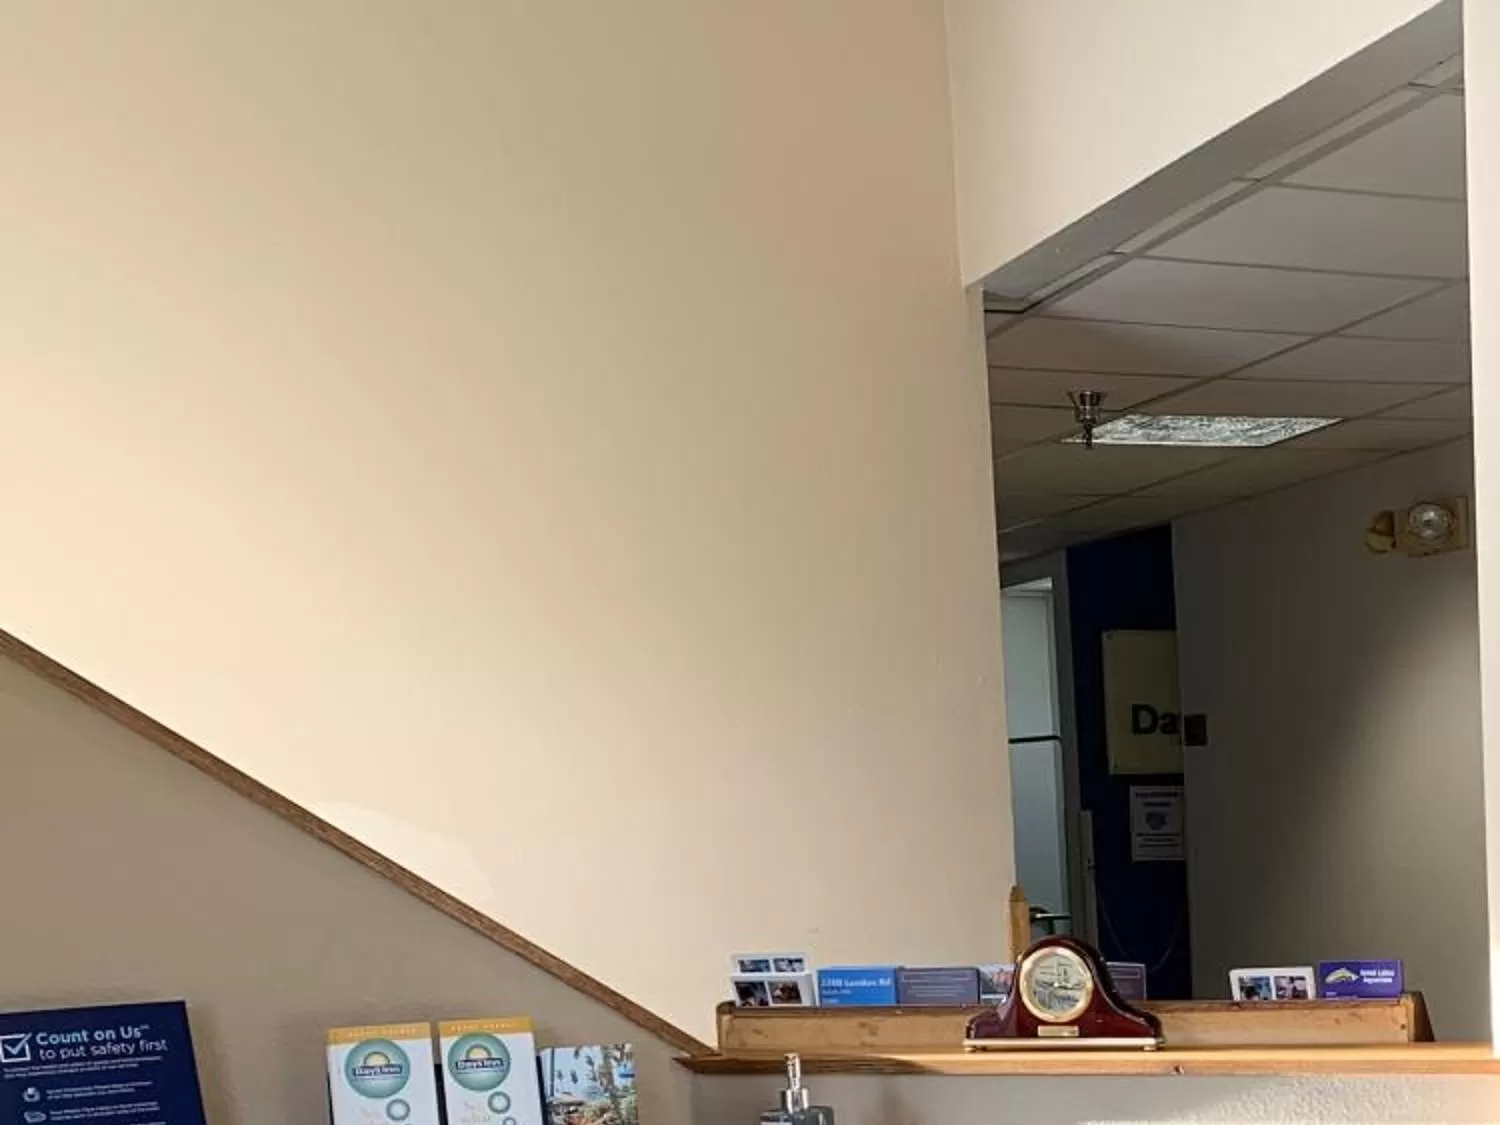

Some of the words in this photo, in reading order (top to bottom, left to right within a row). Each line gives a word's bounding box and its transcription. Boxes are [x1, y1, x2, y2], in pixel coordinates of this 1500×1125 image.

[35, 1029, 89, 1045] Count
[93, 1029, 116, 1041] on
[39, 1048, 57, 1061] to
[60, 1045, 87, 1060] put
[90, 1041, 135, 1056] safety
[139, 1039, 168, 1052] first
